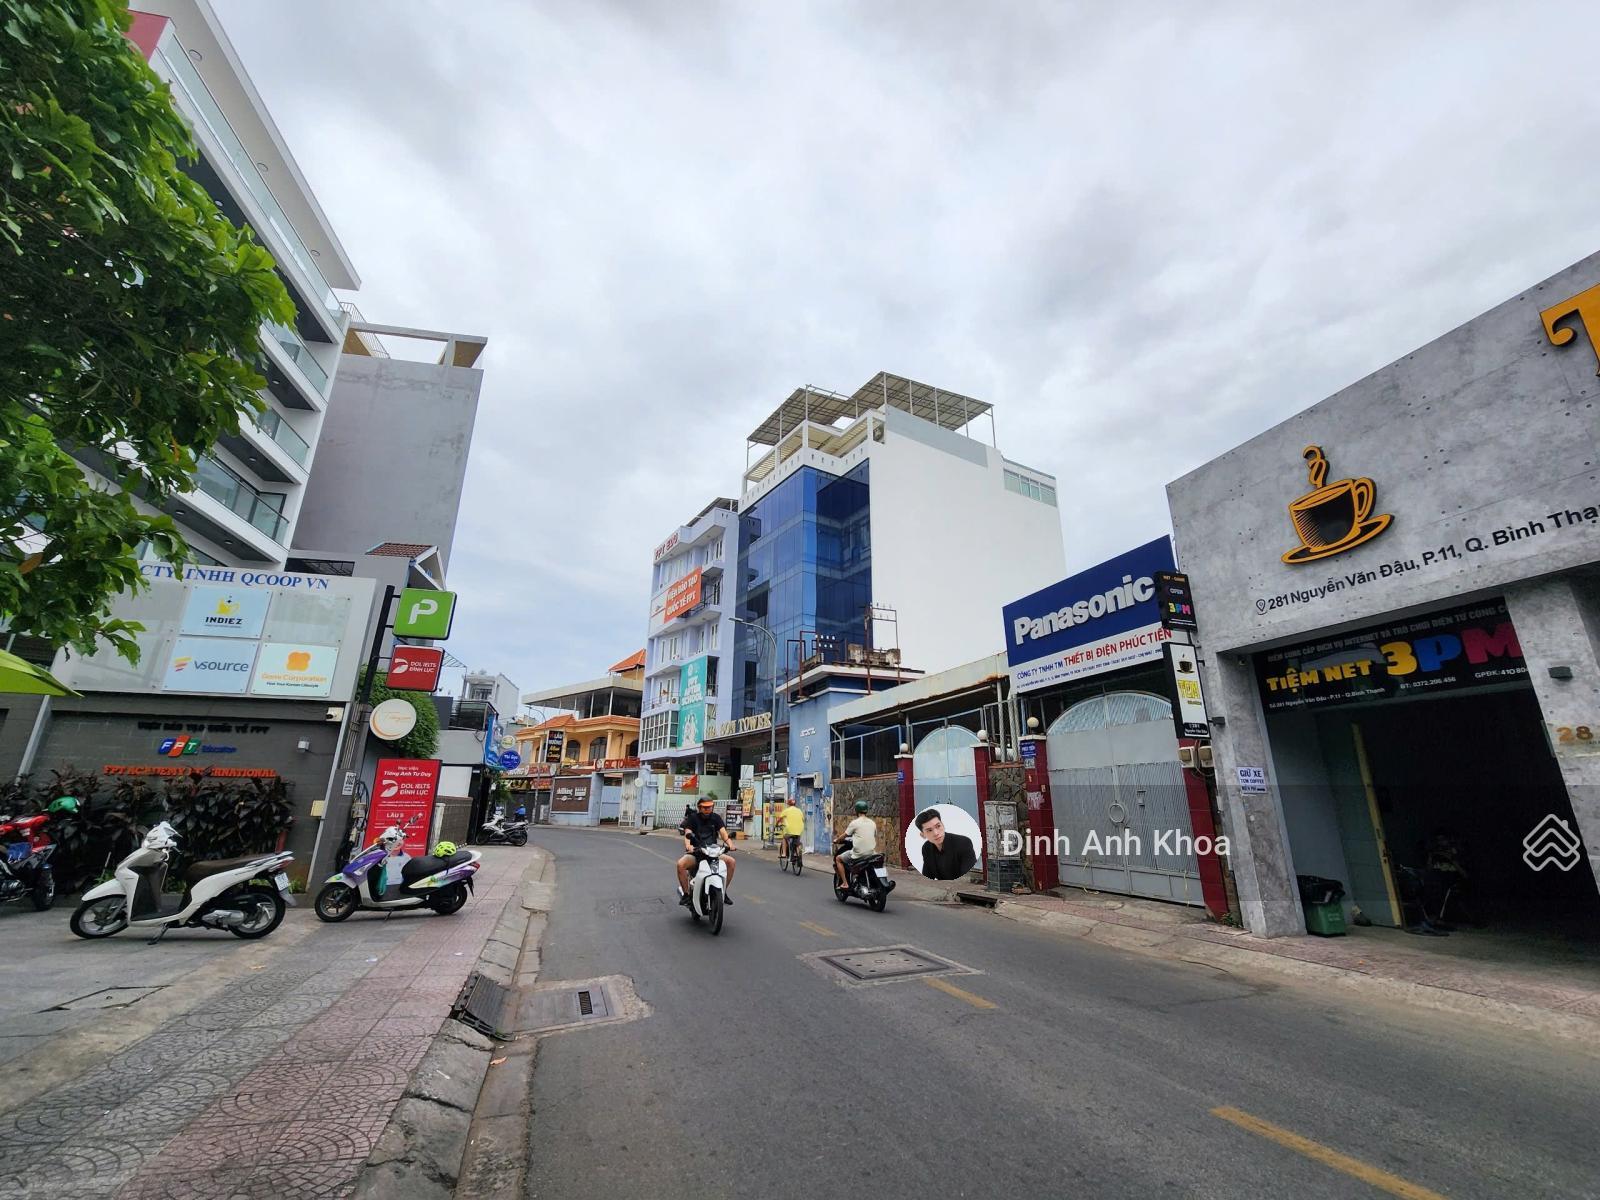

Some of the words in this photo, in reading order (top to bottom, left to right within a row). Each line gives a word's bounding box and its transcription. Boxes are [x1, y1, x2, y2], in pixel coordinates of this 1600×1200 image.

[1268, 596, 1289, 610] 281
[1290, 576, 1345, 605] Nguyễn
[1346, 569, 1376, 587] Văn
[1380, 559, 1420, 578] Đậu,
[1422, 544, 1462, 566] P.11,
[1465, 537, 1488, 553] Q.
[1493, 521, 1545, 546] Bình
[1547, 502, 1600, 529] Thạ
[140, 564, 174, 579] CTY
[184, 568, 236, 583] TNHH
[241, 572, 301, 588] QCOOP
[307, 577, 330, 590] VN
[205, 616, 243, 625] INDIEZ
[408, 598, 439, 624] P
[1014, 575, 1156, 645] Panasonic
[194, 660, 249, 672] vsource
[1017, 669, 1032, 680] CÔNG
[1031, 668, 1039, 676] TY
[1039, 663, 1054, 674] TNHH
[1054, 660, 1063, 669] TM
[1063, 651, 1085, 667] THIẾT
[1085, 650, 1094, 661] BỊ
[1096, 643, 1118, 658] ĐIỆN
[1119, 634, 1146, 651] PHÚC
[1266, 667, 1320, 693] TIỆM
[1323, 660, 1372, 682] NET
[1380, 622, 1524, 676] 3PM
[160, 739, 199, 753] FPT
[103, 765, 127, 776] FPT
[1253, 770, 1262, 778] XE
